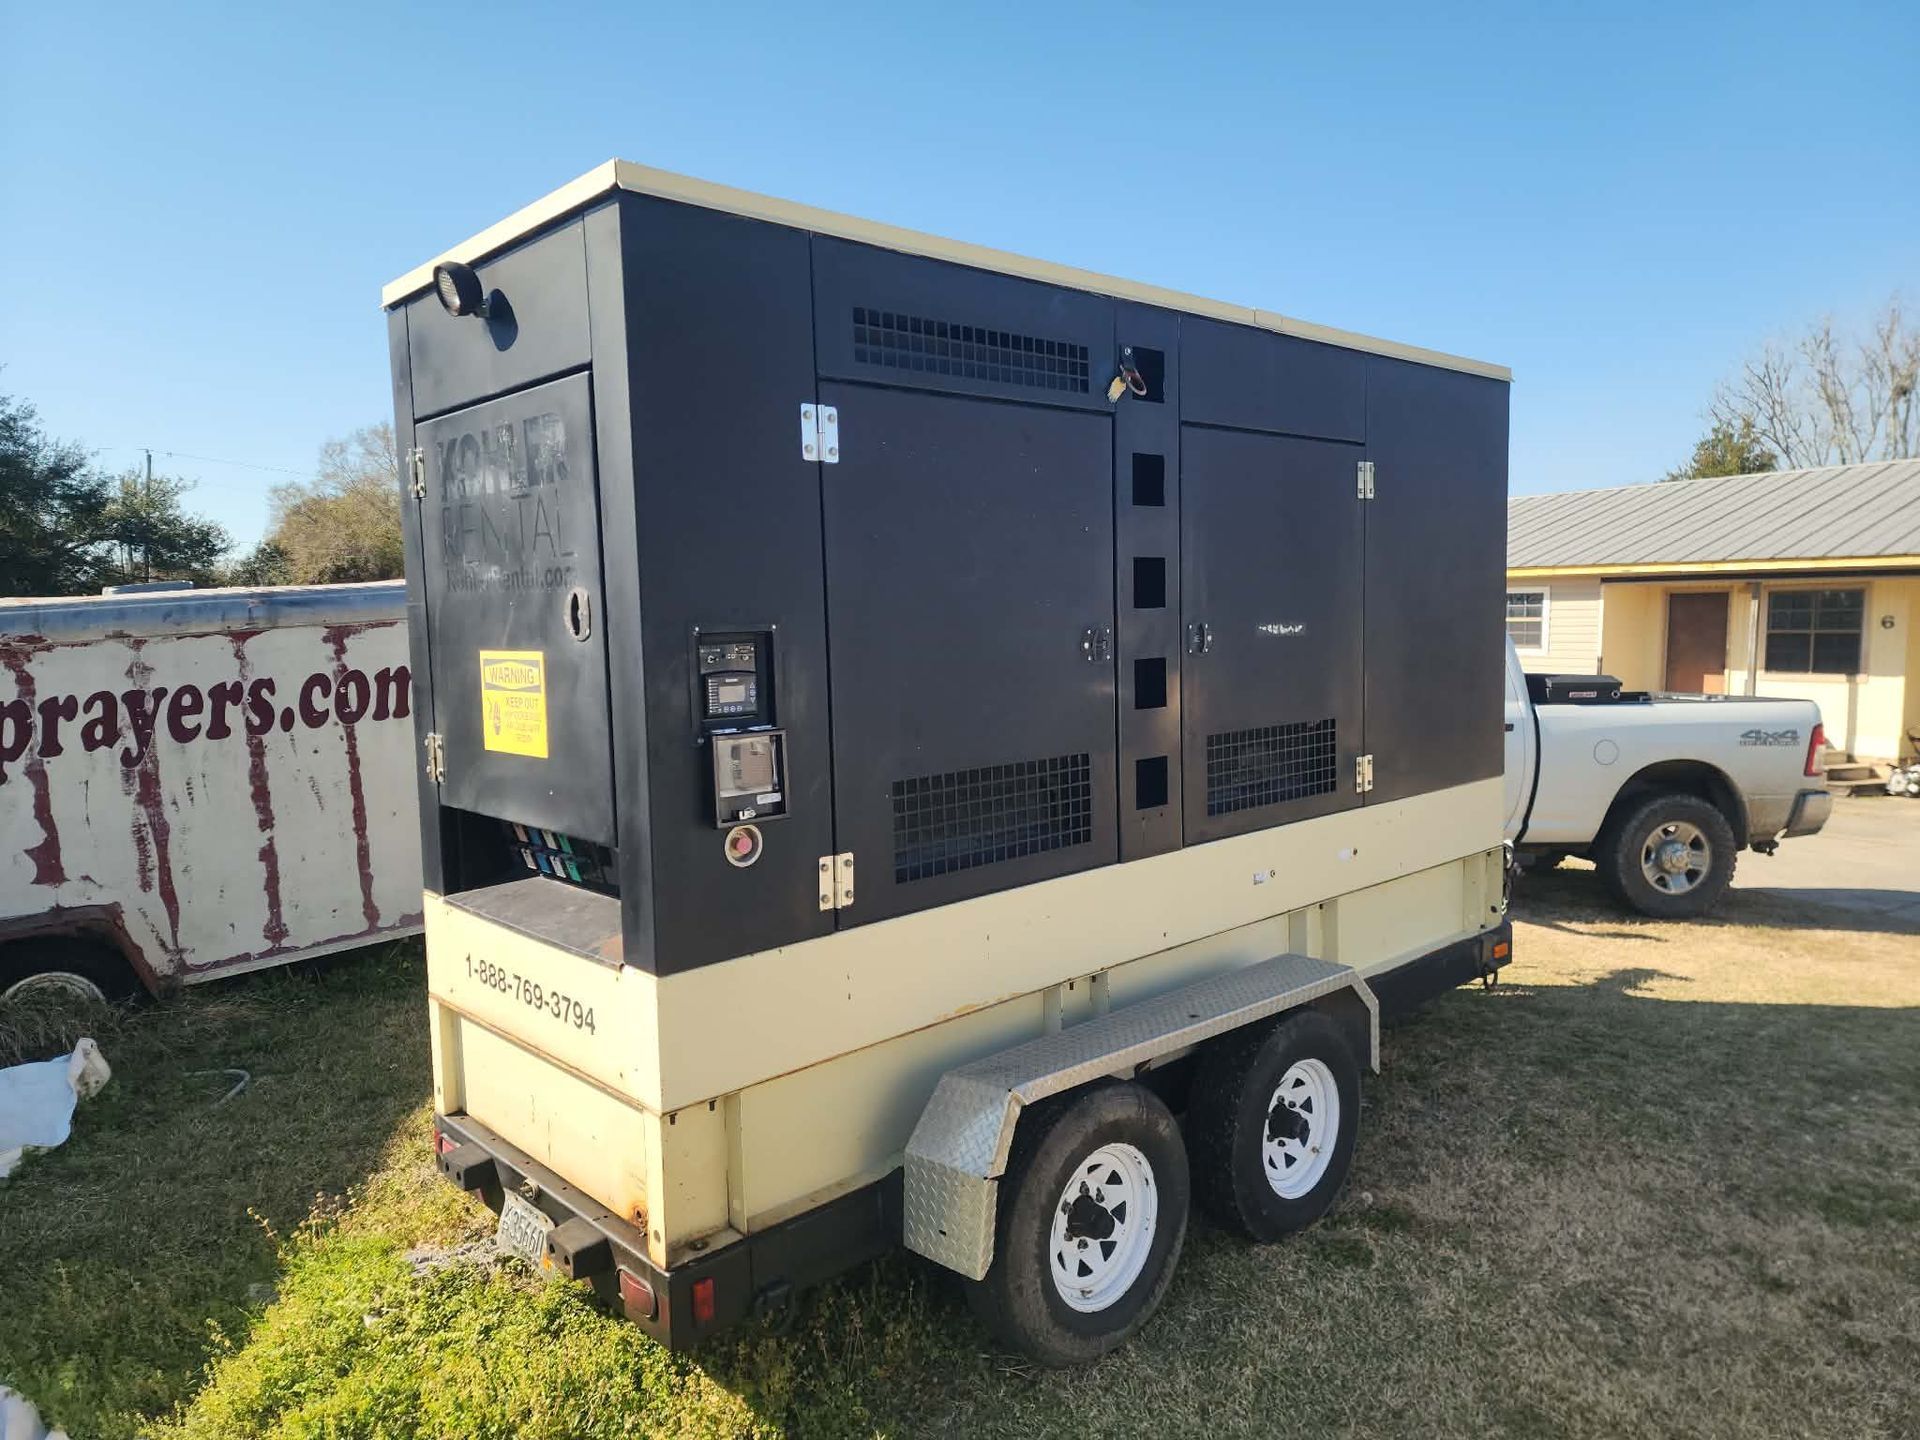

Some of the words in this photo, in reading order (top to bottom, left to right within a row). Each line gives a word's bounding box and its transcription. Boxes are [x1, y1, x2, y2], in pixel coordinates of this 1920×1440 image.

[1881, 614, 1895, 629] 6
[489, 666, 534, 685] WARNING
[1739, 728, 1800, 742] 4x4
[466, 952, 596, 1036] 1-888-769-3794
